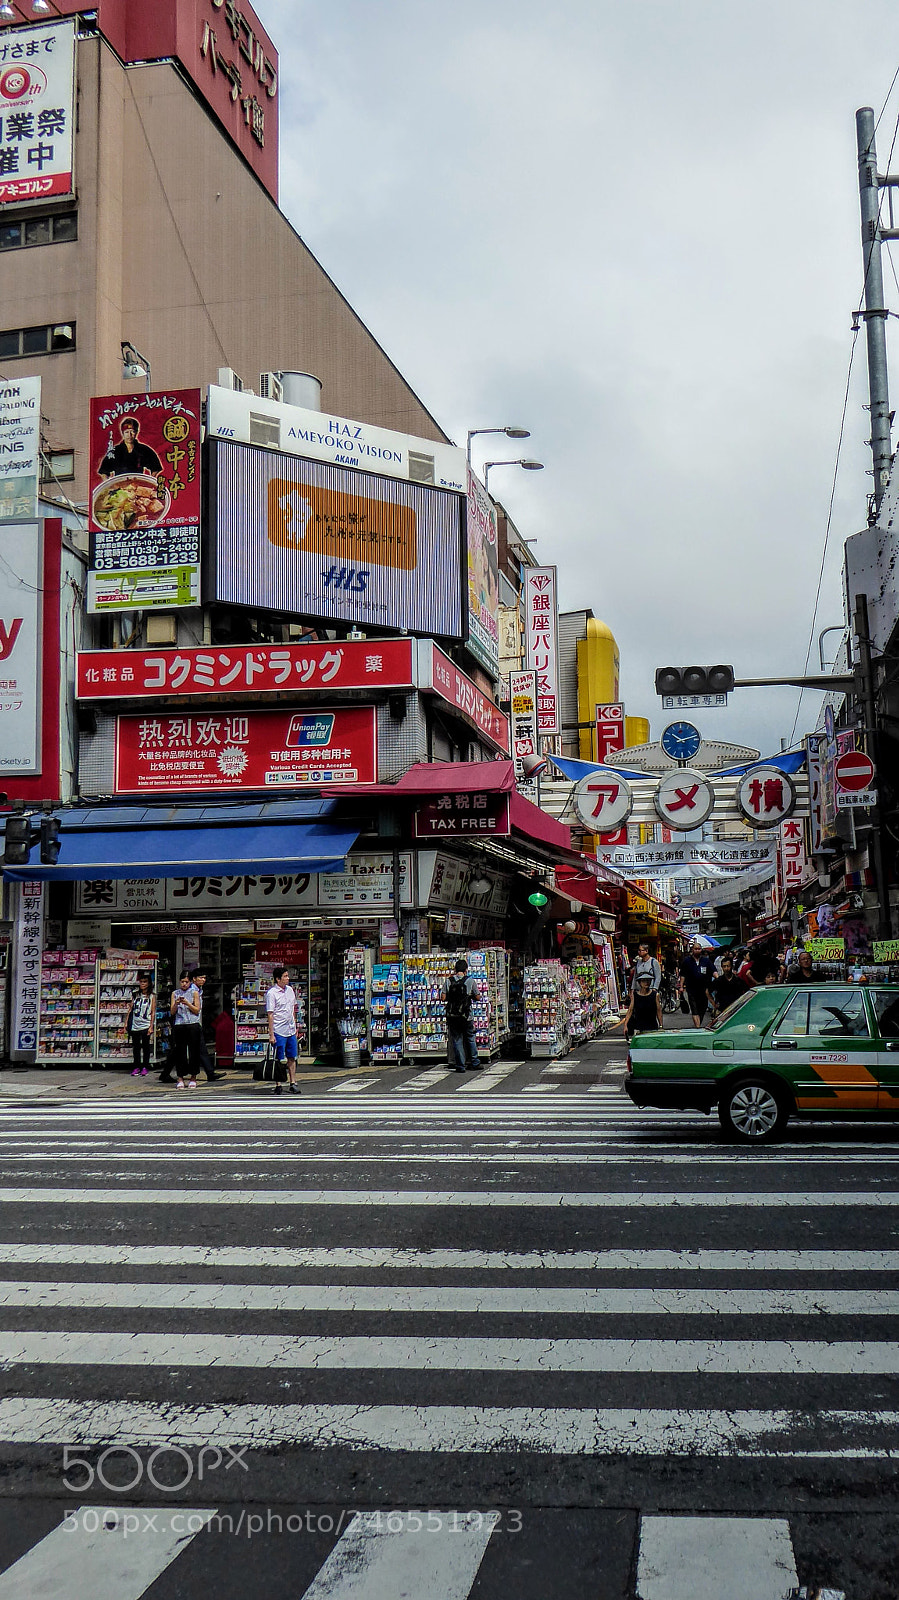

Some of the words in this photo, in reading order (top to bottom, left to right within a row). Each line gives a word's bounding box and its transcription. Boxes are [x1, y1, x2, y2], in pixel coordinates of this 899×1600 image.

[0, 108, 66, 145] 業祭
[288, 427, 354, 451] AMEYOKO
[357, 443, 402, 463] VISION
[335, 454, 359, 466] AKAMI
[166, 445, 185, 500] 中本
[95, 551, 199, 570] 03-5688-1233
[532, 594, 552, 692] 銀座パリス
[85, 667, 134, 682] 化粧品
[143, 648, 344, 689] コクミンドラッグ
[365, 655, 383, 673] 薬
[666, 695, 725, 707] 自転車専用
[138, 717, 250, 748] 热烈欢迎
[292, 721, 331, 733] UnionPay
[437, 794, 488, 810] 免税店
[429, 818, 456, 830] TAX
[461, 817, 496, 829] FREE
[615, 850, 685, 863] 国立西洋美術館
[690, 848, 770, 861] 世界文化遺産登録
[124, 899, 159, 907] SOFINA
[828, 1054, 847, 1062] 7229
